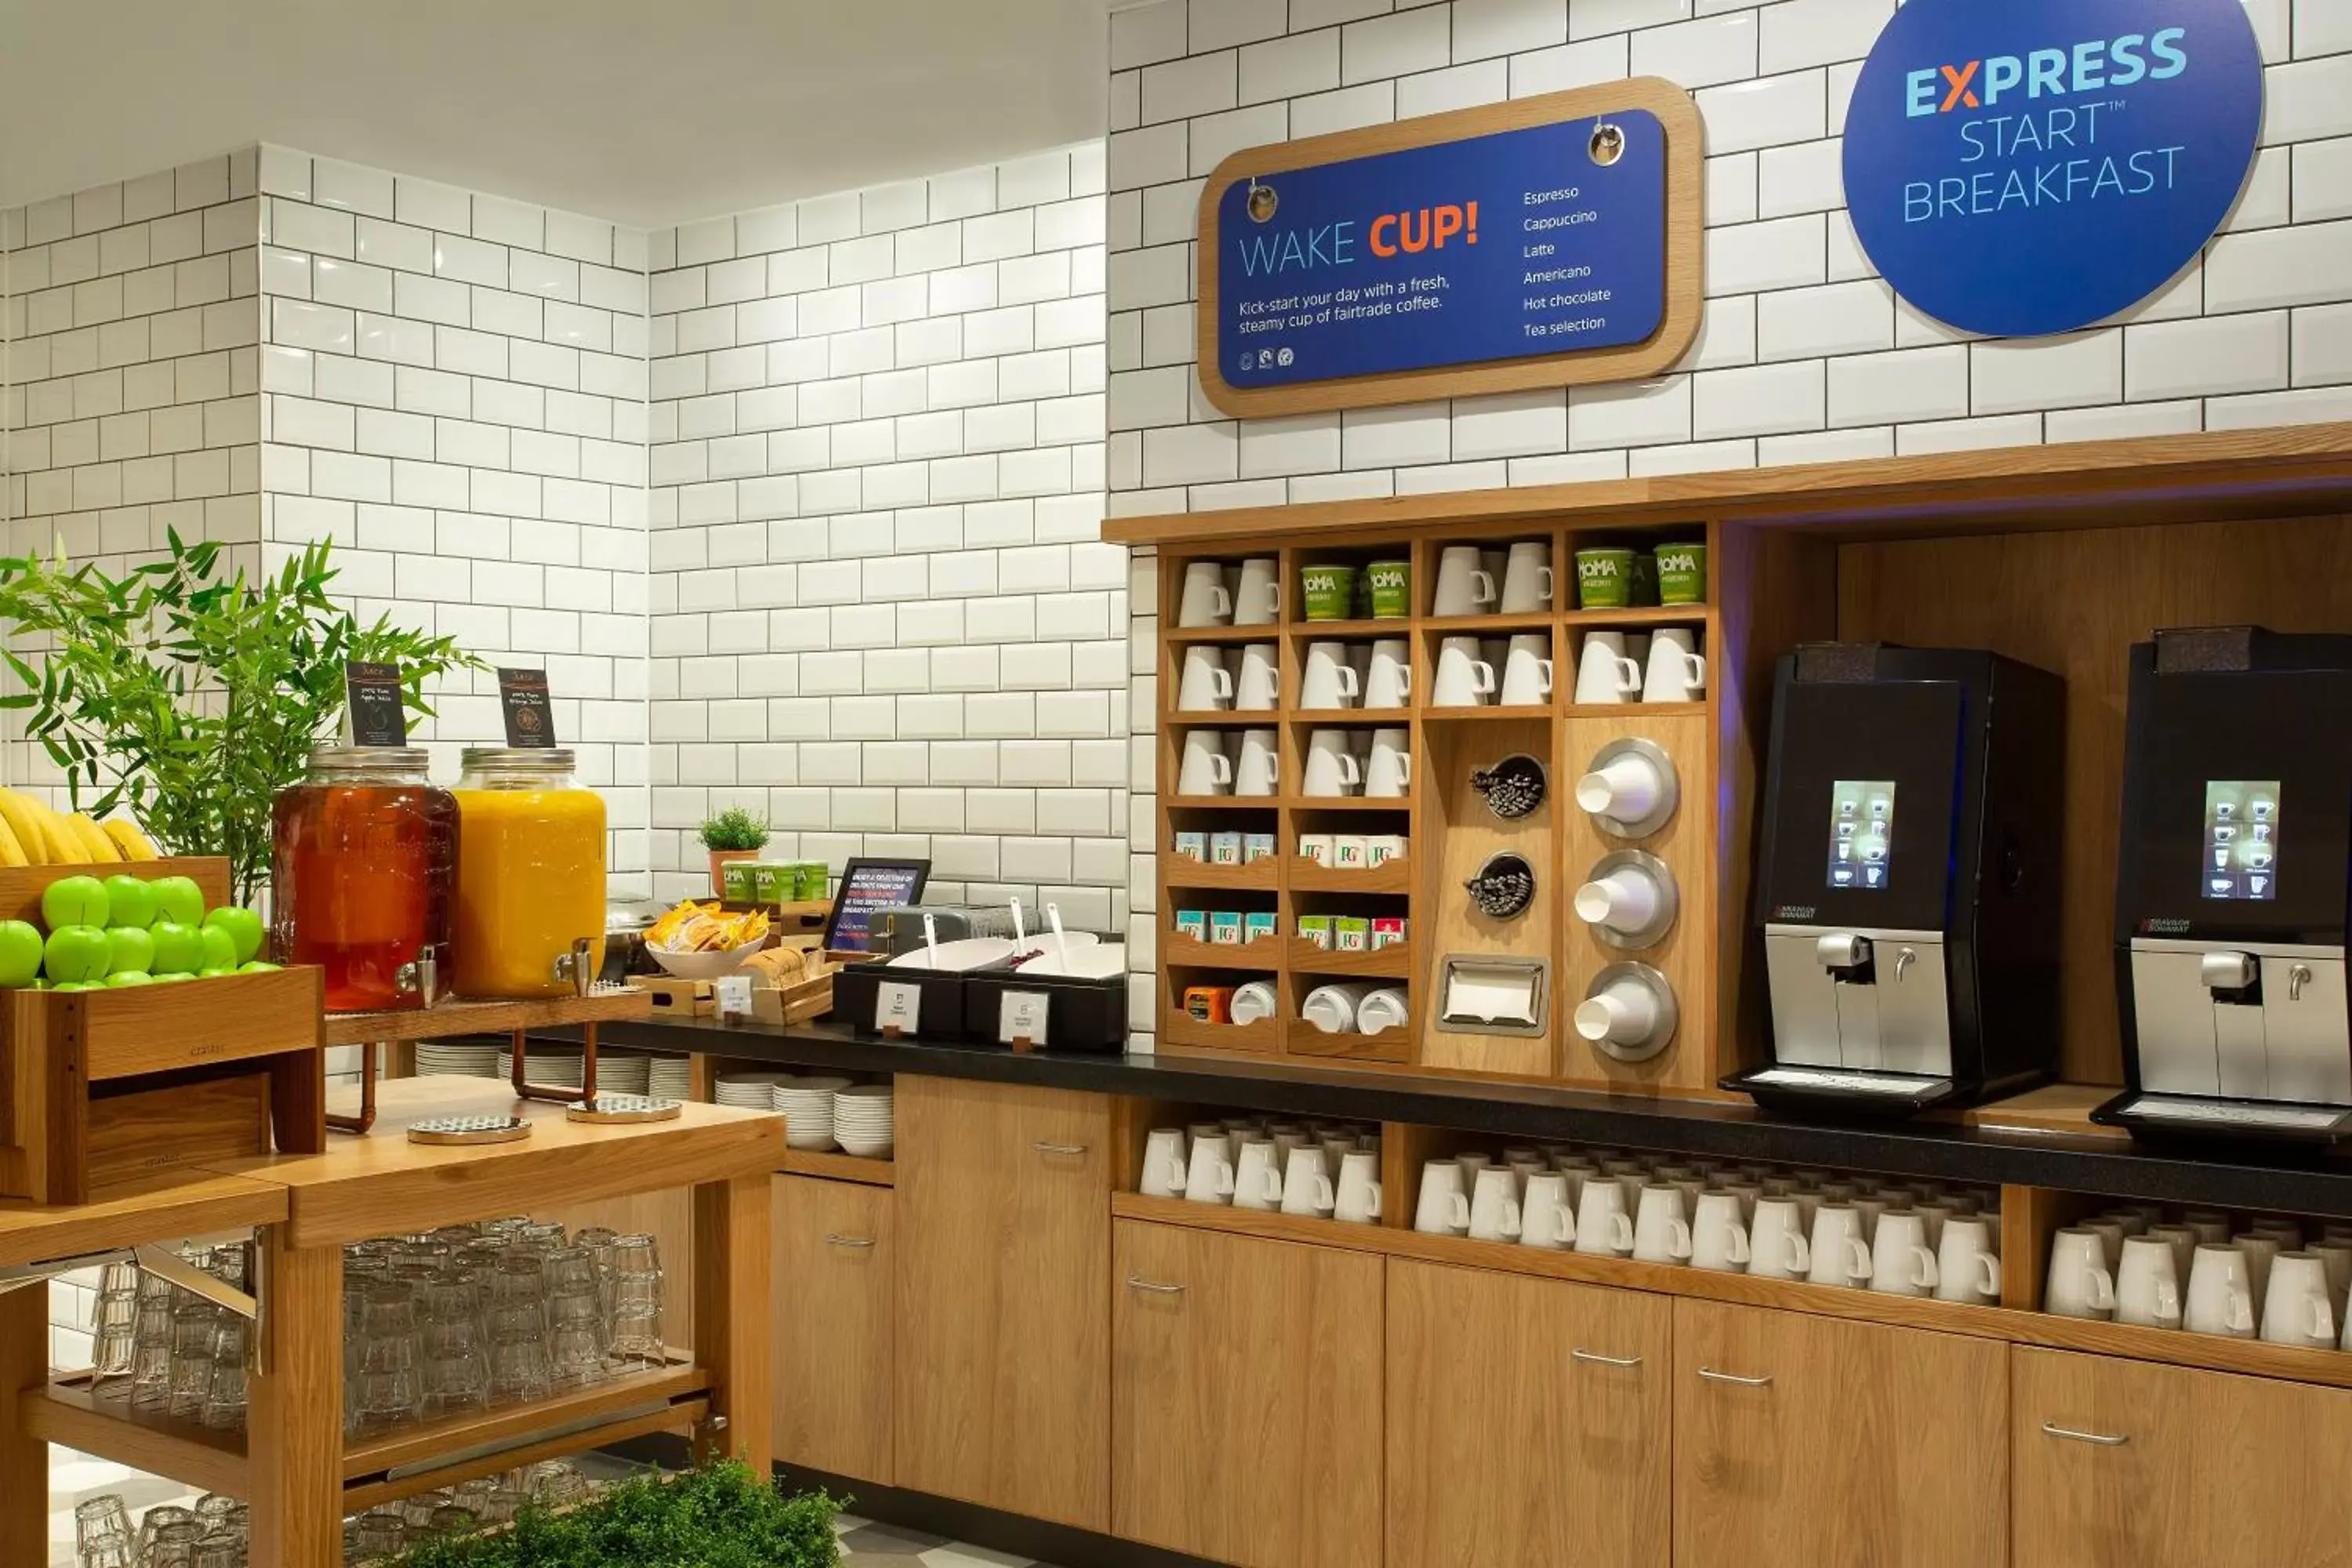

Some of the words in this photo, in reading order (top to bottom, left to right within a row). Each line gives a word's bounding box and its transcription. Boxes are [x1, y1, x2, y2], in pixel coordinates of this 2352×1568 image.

[1906, 27, 2187, 118] EXPRESS
[1904, 146, 2186, 223] BREAKFAST
[1523, 187, 1579, 205] Espresso
[1523, 210, 1597, 231] Cappuccino
[1239, 220, 1356, 277] WAKE
[1370, 200, 1478, 257] CUP!
[1523, 244, 1555, 259] Latte
[1523, 266, 1591, 285] Americano
[1239, 295, 1299, 316] Kick-start
[1301, 292, 1333, 309] your
[1334, 287, 1361, 303] day
[1363, 281, 1393, 298] with
[1397, 282, 1406, 295] a
[1523, 297, 1547, 311] Hot
[1550, 289, 1612, 307] chocolate
[1239, 317, 1286, 334] steamy
[1288, 312, 1314, 327] cup
[1316, 307, 1331, 323] of
[1334, 300, 1392, 321] fairtrade
[1396, 294, 1443, 314] coffee.
[1523, 323, 1548, 336] Tea
[1549, 317, 1607, 335] selection
[1341, 846, 1360, 862] PG
